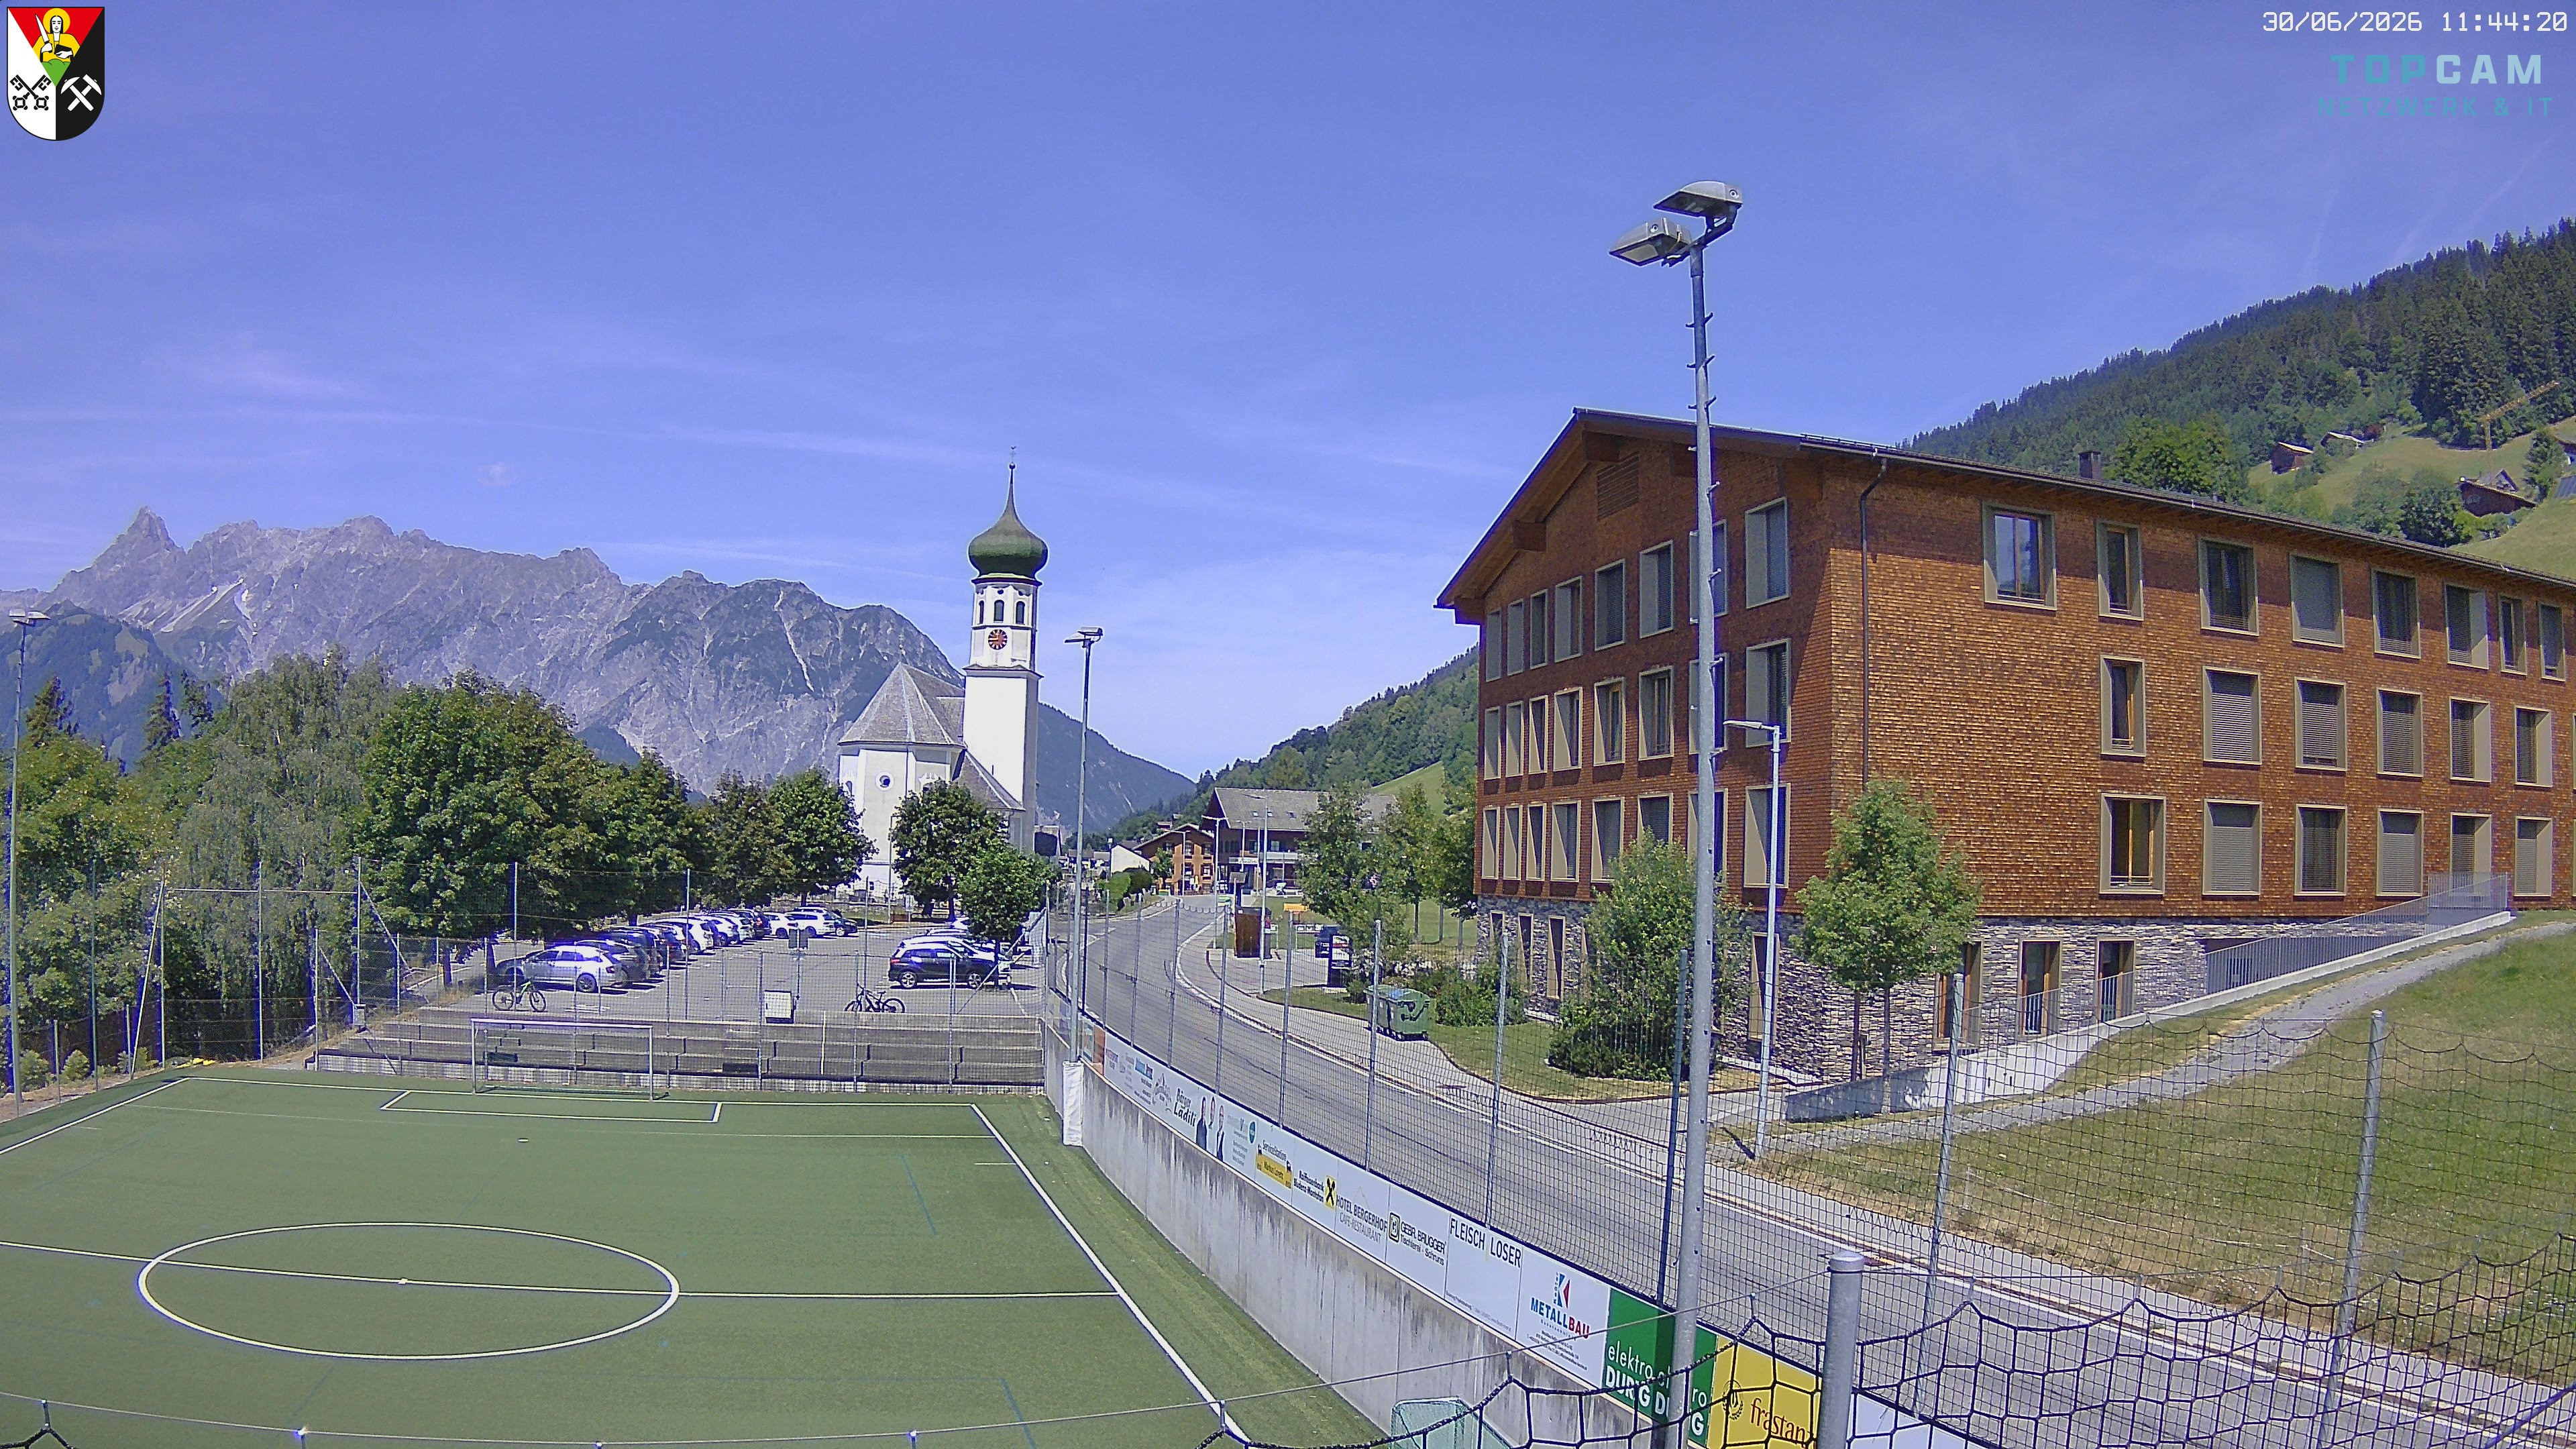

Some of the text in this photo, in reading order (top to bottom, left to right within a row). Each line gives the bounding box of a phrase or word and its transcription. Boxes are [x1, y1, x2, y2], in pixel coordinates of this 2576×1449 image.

[1336, 1195, 1352, 1214] HOTEL
[1354, 1204, 1387, 1232] BERGERHOF
[1417, 1230, 1445, 1254] BRUGGER
[1450, 1218, 1521, 1268] FLEISCH LOSER
[1531, 1297, 1590, 1339] METALLBAU
[1608, 1340, 1653, 1379] elektro
